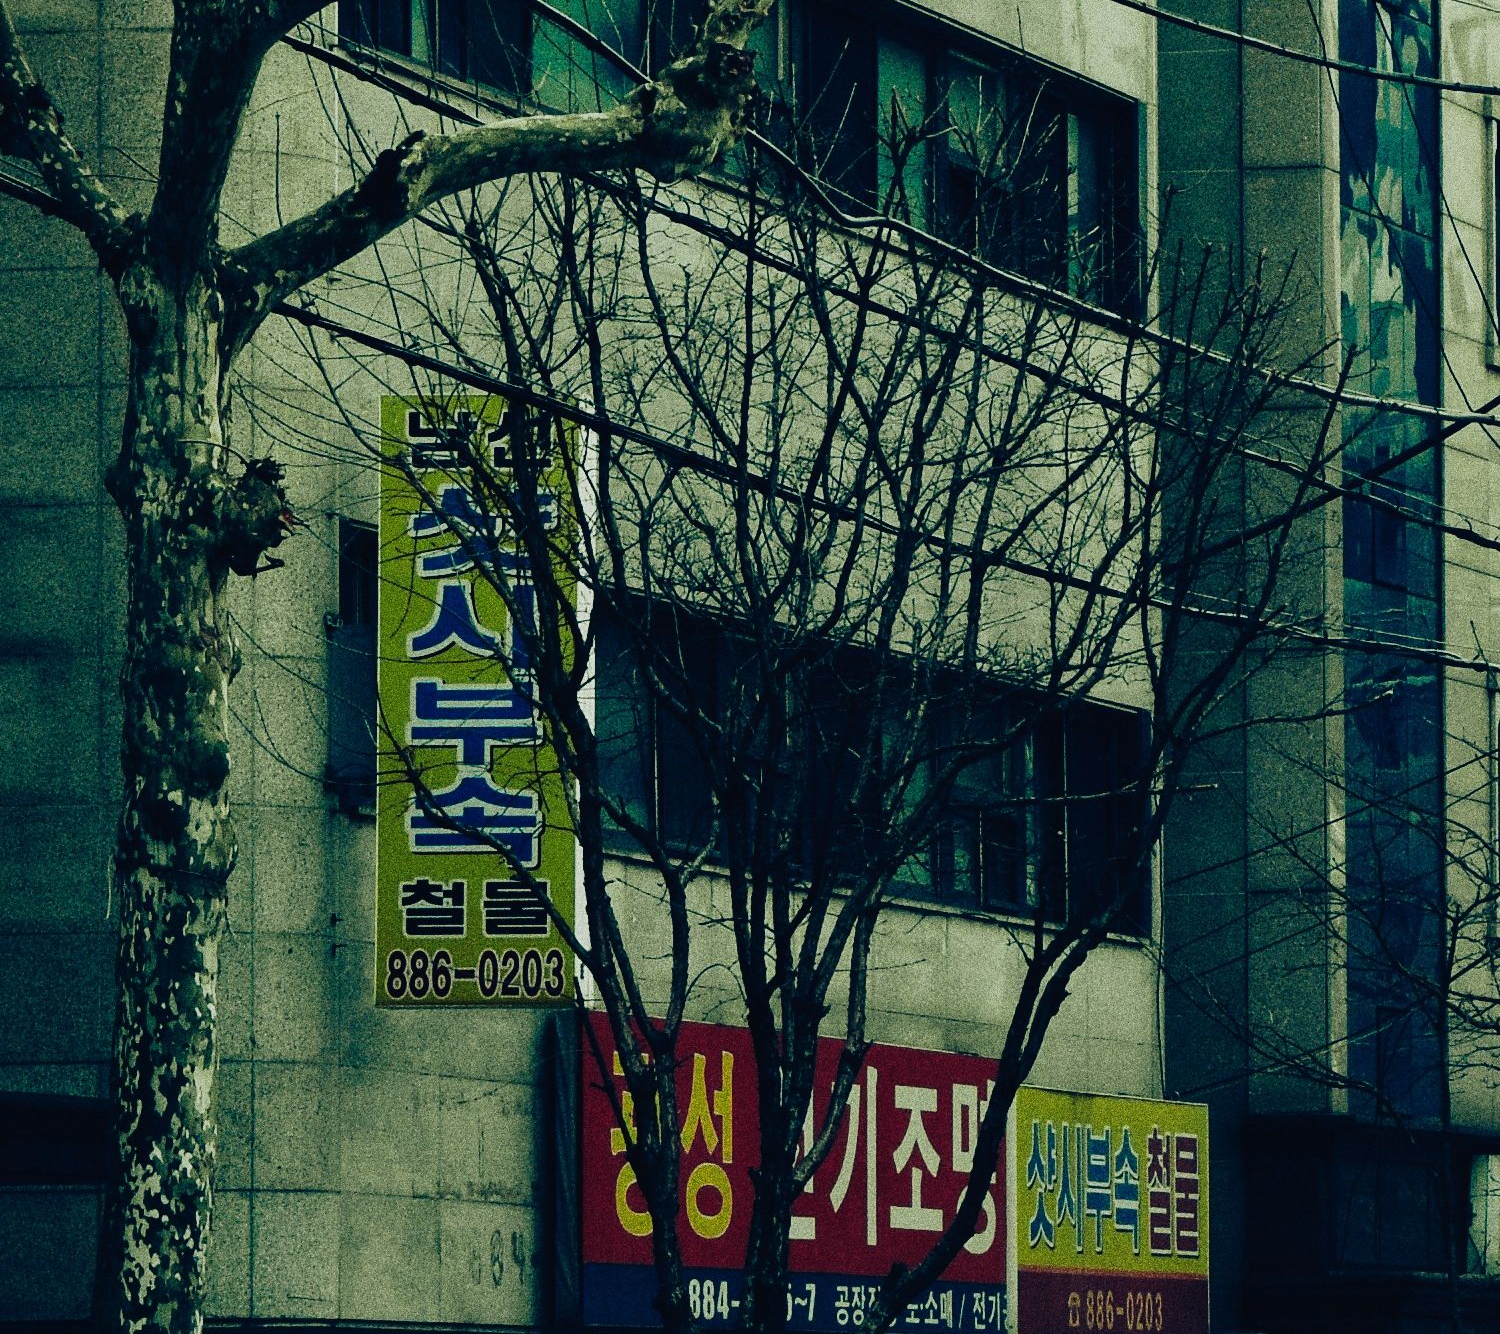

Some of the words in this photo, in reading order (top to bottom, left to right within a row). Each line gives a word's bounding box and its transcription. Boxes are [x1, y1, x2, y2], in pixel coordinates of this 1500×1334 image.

[402, 878, 549, 936] 철물
[386, 951, 564, 999] 886-0203
[1027, 1119, 1139, 1258] 샷시부속
[1145, 1124, 1199, 1259] 철물
[1085, 1291, 1164, 1333] 886-0203
